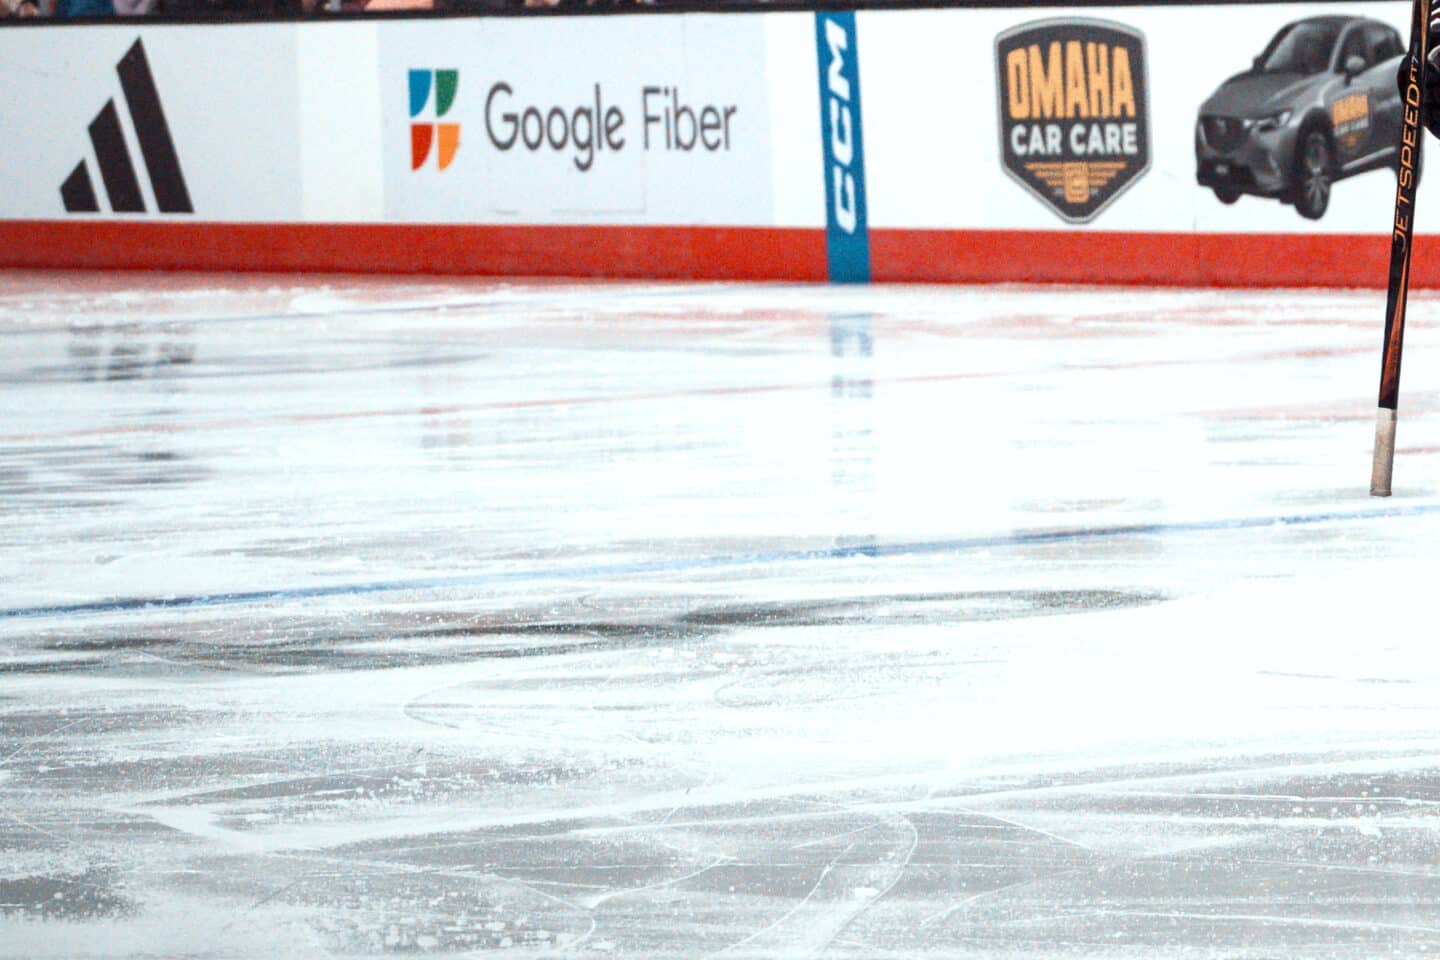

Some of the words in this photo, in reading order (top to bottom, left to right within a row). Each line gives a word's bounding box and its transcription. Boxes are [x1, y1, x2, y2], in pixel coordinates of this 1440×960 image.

[1007, 40, 1136, 119] OMAHA
[485, 81, 624, 172] Google
[642, 86, 737, 151] Fiber
[825, 18, 857, 235] CCM
[1011, 124, 1063, 155] CAR
[1069, 123, 1138, 154] CARE
[1394, 83, 1420, 253] JETSPEED
